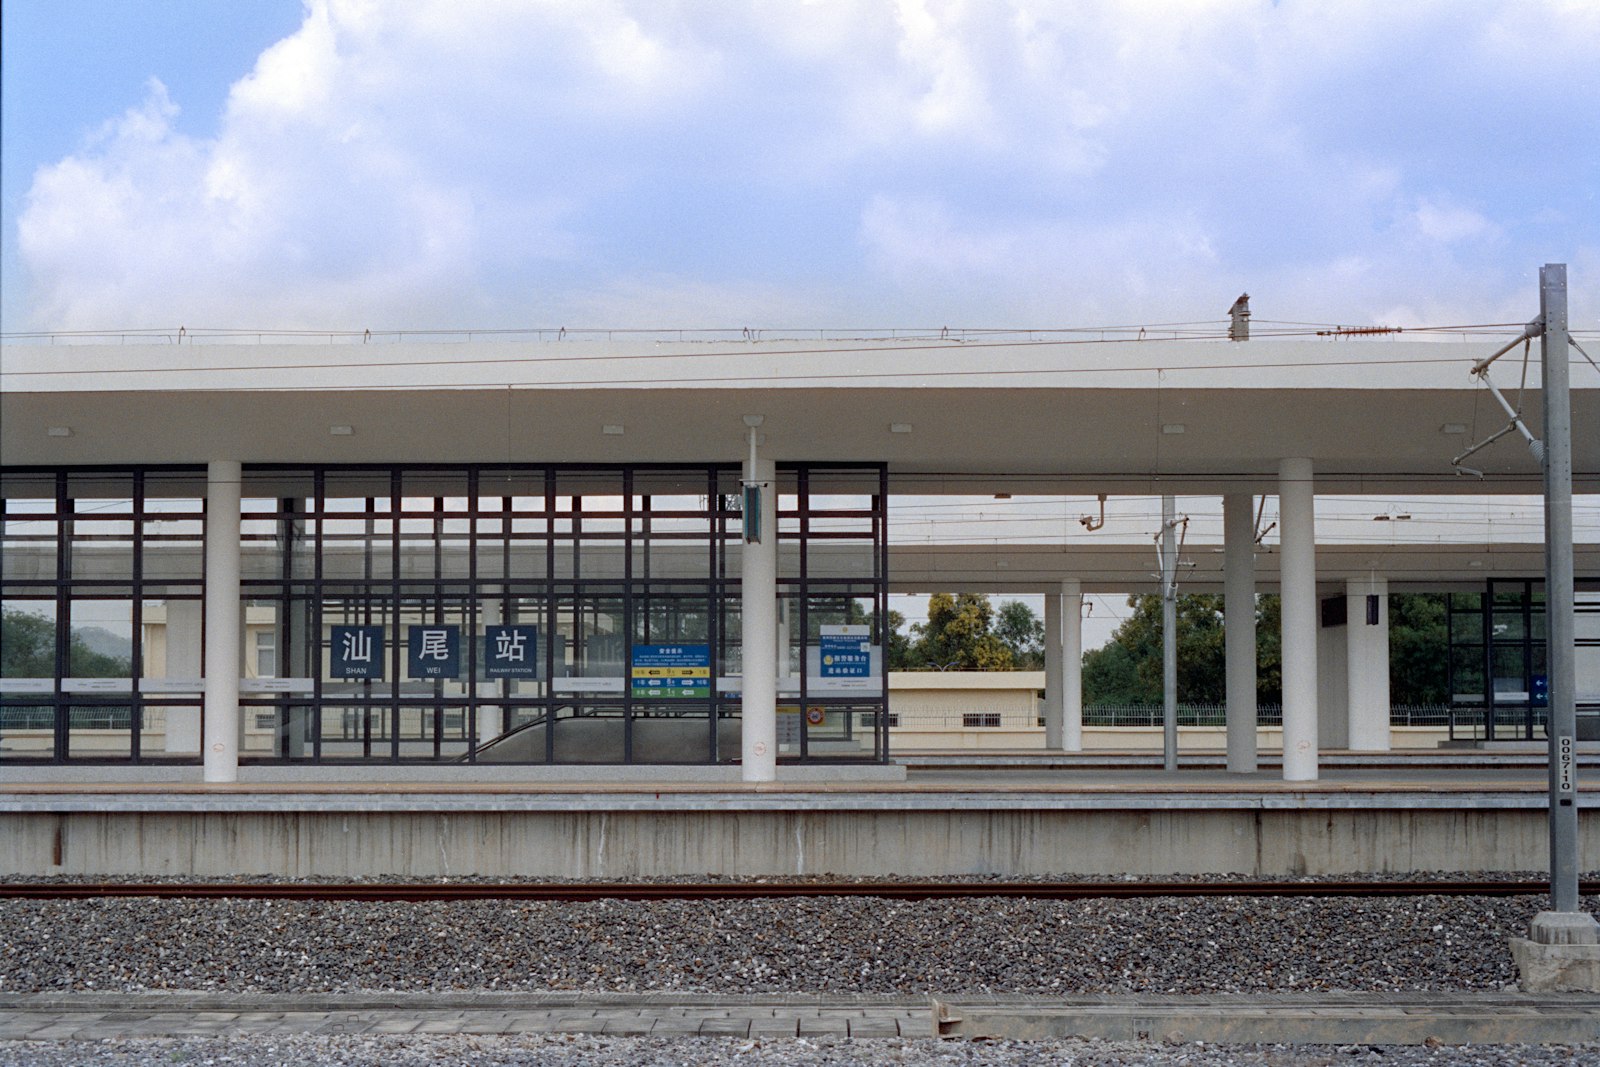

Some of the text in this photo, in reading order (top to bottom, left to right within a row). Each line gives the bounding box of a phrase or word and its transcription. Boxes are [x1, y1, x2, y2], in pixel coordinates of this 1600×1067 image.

[342, 629, 527, 662] 汕 尾 站
